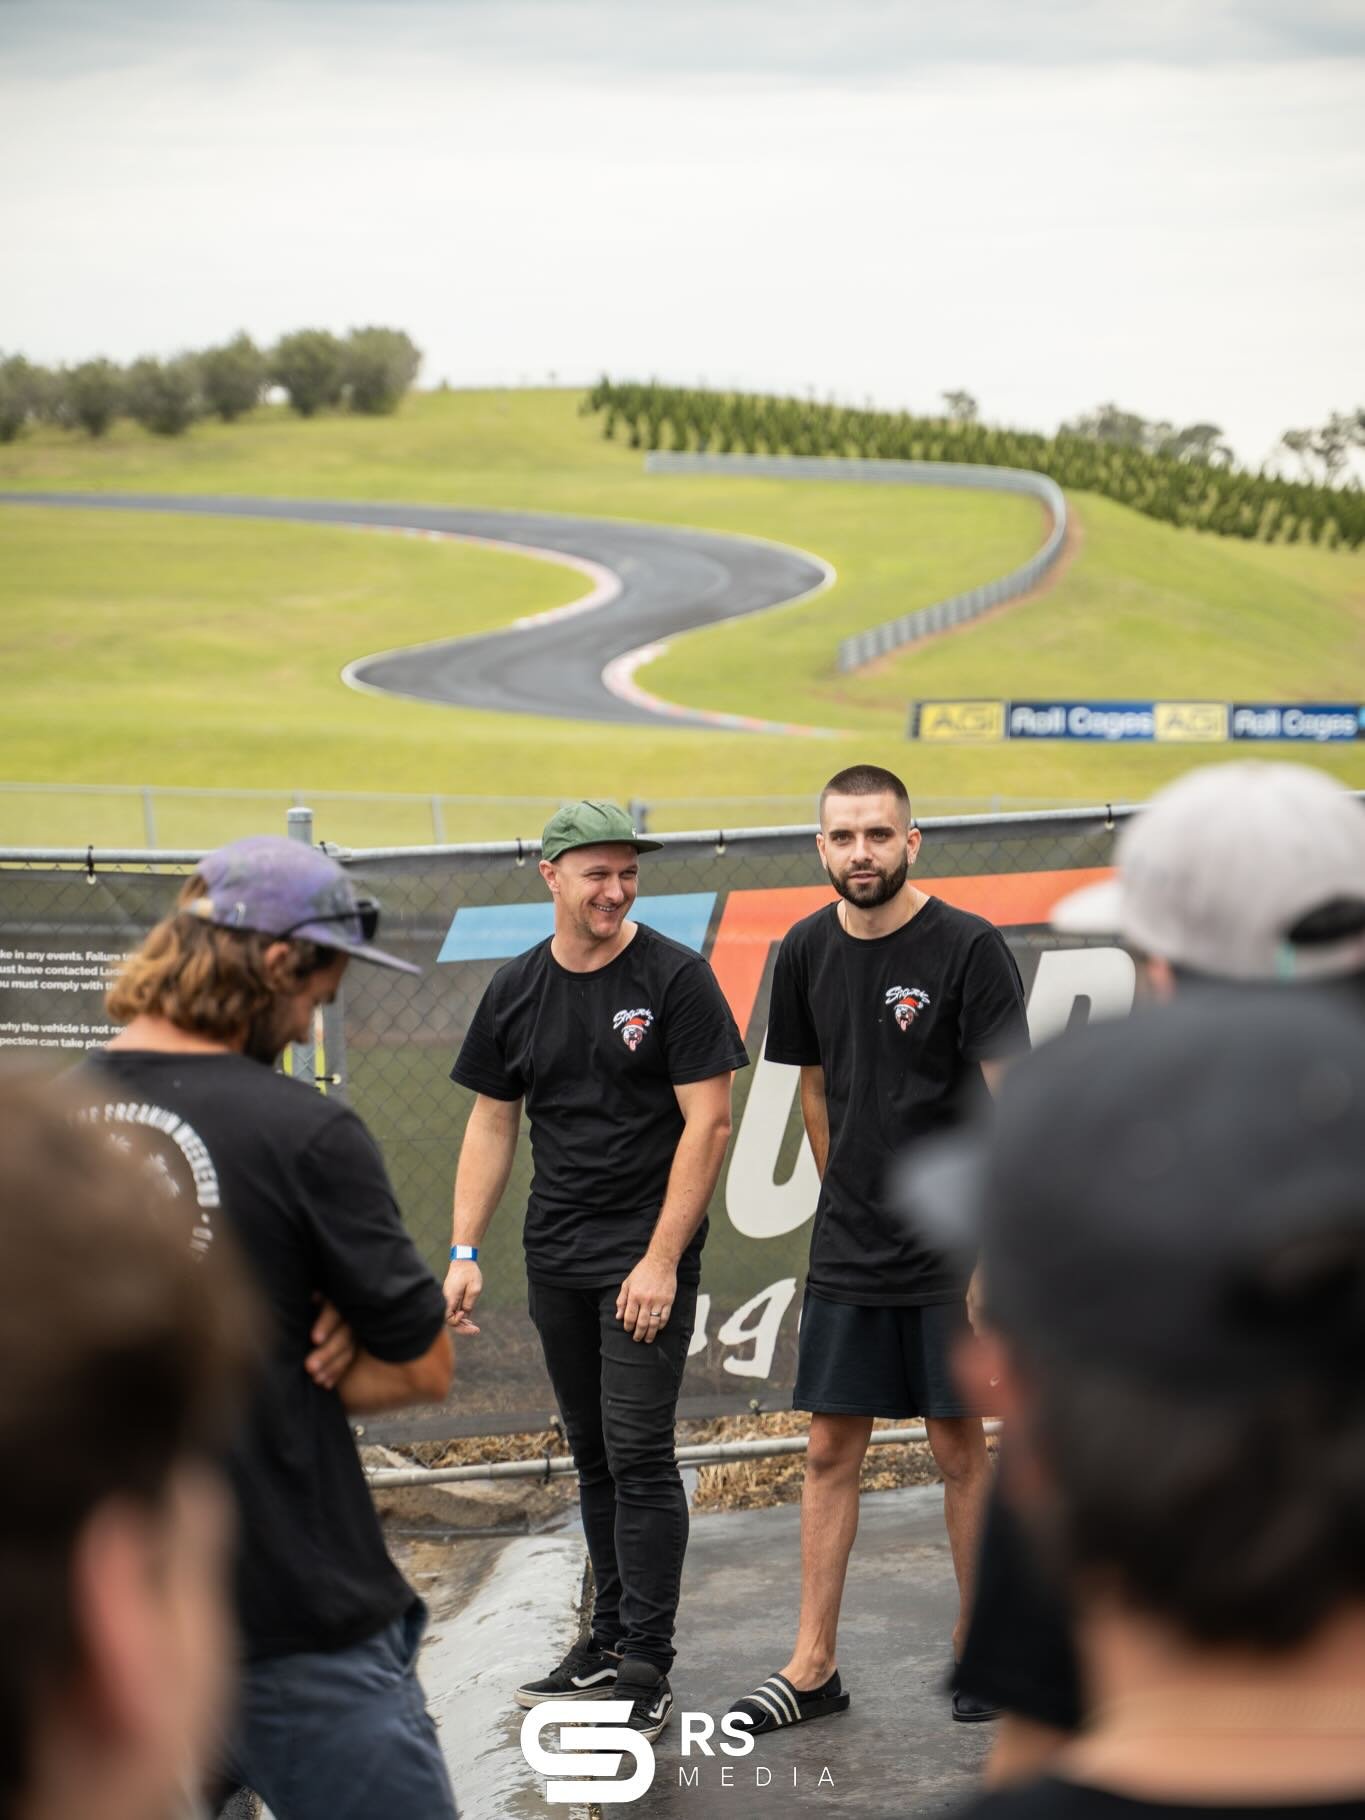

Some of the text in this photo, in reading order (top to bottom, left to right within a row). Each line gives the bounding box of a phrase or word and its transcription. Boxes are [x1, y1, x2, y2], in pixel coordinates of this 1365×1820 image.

[14, 950, 24, 960] in
[26, 952, 44, 962] any
[46, 952, 83, 961] events.
[85, 952, 121, 961] Failure
[18, 966, 43, 975] have
[45, 967, 98, 976] contacted
[11, 980, 39, 989] must
[40, 980, 80, 992] comply
[81, 981, 104, 991] with
[0, 1022, 20, 1033] why
[22, 1023, 39, 1032] the
[41, 1024, 78, 1034] vehicle
[80, 1025, 89, 1033] is
[91, 1025, 109, 1034] not
[40, 1039, 58, 1048] can
[60, 1039, 84, 1048] take
